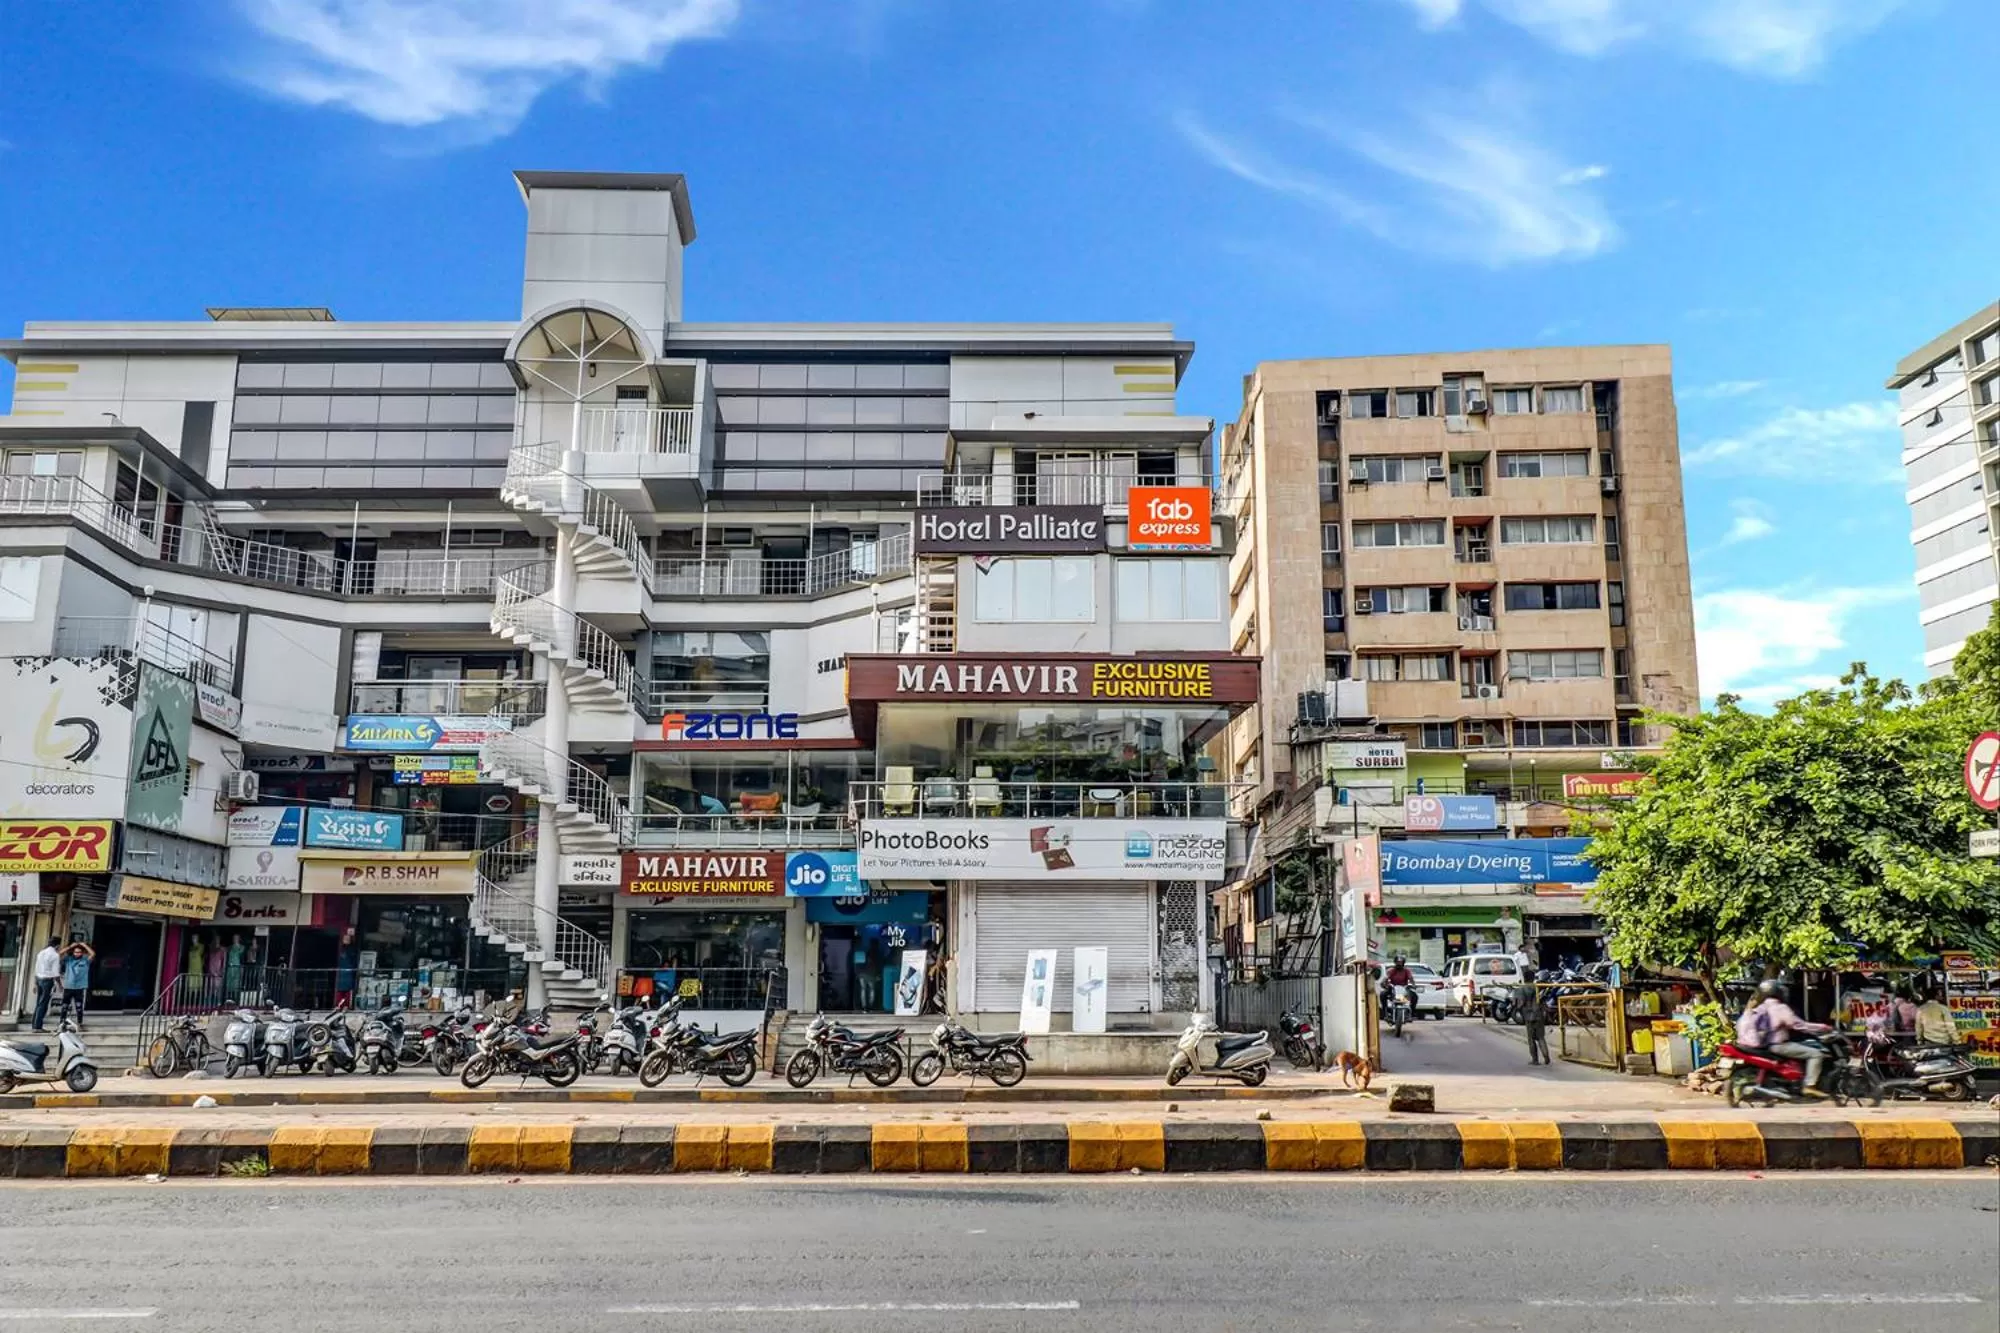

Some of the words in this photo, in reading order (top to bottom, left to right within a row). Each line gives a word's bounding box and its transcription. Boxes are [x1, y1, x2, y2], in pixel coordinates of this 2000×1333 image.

[1147, 498, 1193, 519] fab
[920, 514, 990, 541] Hotel
[1000, 514, 1098, 540] Palliate
[1139, 522, 1200, 537] express
[896, 664, 1079, 695] MAHAVIR
[1093, 663, 1210, 680] EXCLUSIVE
[1091, 681, 1213, 697] FURNITURE
[352, 724, 415, 741] SAHARA
[1356, 757, 1404, 767] SURBHI
[26, 782, 95, 795] decorators
[1576, 783, 1610, 796] HOTEL
[1408, 799, 1436, 816] go
[861, 829, 989, 849] PhotoBooks
[1158, 838, 1225, 849] mazda
[1158, 850, 1225, 859] IMAGING
[637, 856, 768, 877] MAHAVIR
[863, 859, 877, 867] Let
[878, 859, 899, 867] Your
[901, 859, 935, 867] Pictures
[938, 859, 953, 867] Tell
[963, 859, 987, 869] Story
[1397, 854, 1465, 872] Bombay
[1468, 854, 1532, 872] Dyeing
[238, 874, 287, 886] SARIKA
[790, 864, 826, 885] Jio
[831, 874, 852, 882] LIFE
[630, 881, 700, 893] EXCLUSIVE
[703, 880, 775, 893] FURNITURE
[122, 893, 152, 905] PASSPORT
[154, 899, 175, 908] PHOTO
[196, 905, 213, 913] PHOTO
[224, 897, 287, 918] Sarika
[888, 926, 905, 937] My
[888, 939, 905, 947] Jio
